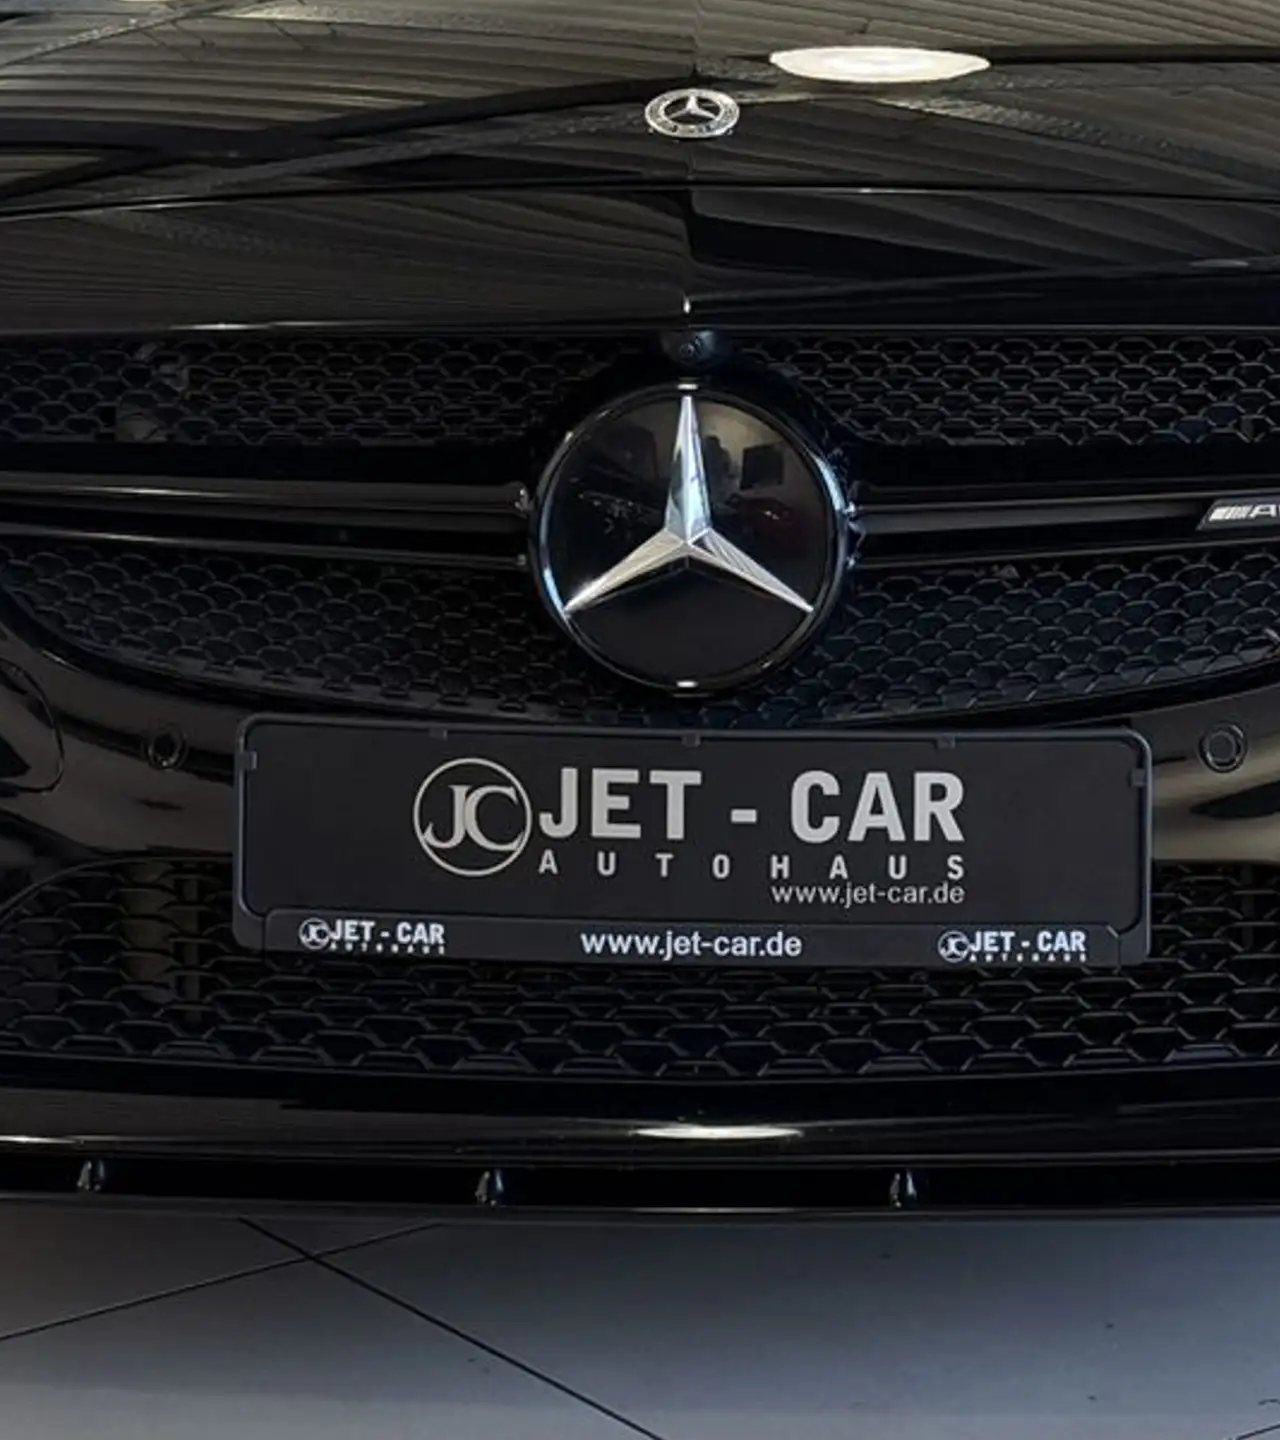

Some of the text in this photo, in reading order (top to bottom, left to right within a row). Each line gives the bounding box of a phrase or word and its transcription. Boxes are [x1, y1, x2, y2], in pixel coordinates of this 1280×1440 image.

[538, 767, 703, 840] JET
[790, 770, 965, 844] CAR
[538, 849, 965, 880] AUTOHAUS
[771, 881, 966, 908] www.jet-car.de
[330, 918, 376, 941] JET
[396, 921, 446, 945] CAR
[580, 930, 803, 961] www.jet-car.de
[969, 930, 1016, 952] JET
[1037, 930, 1087, 952] CAR
